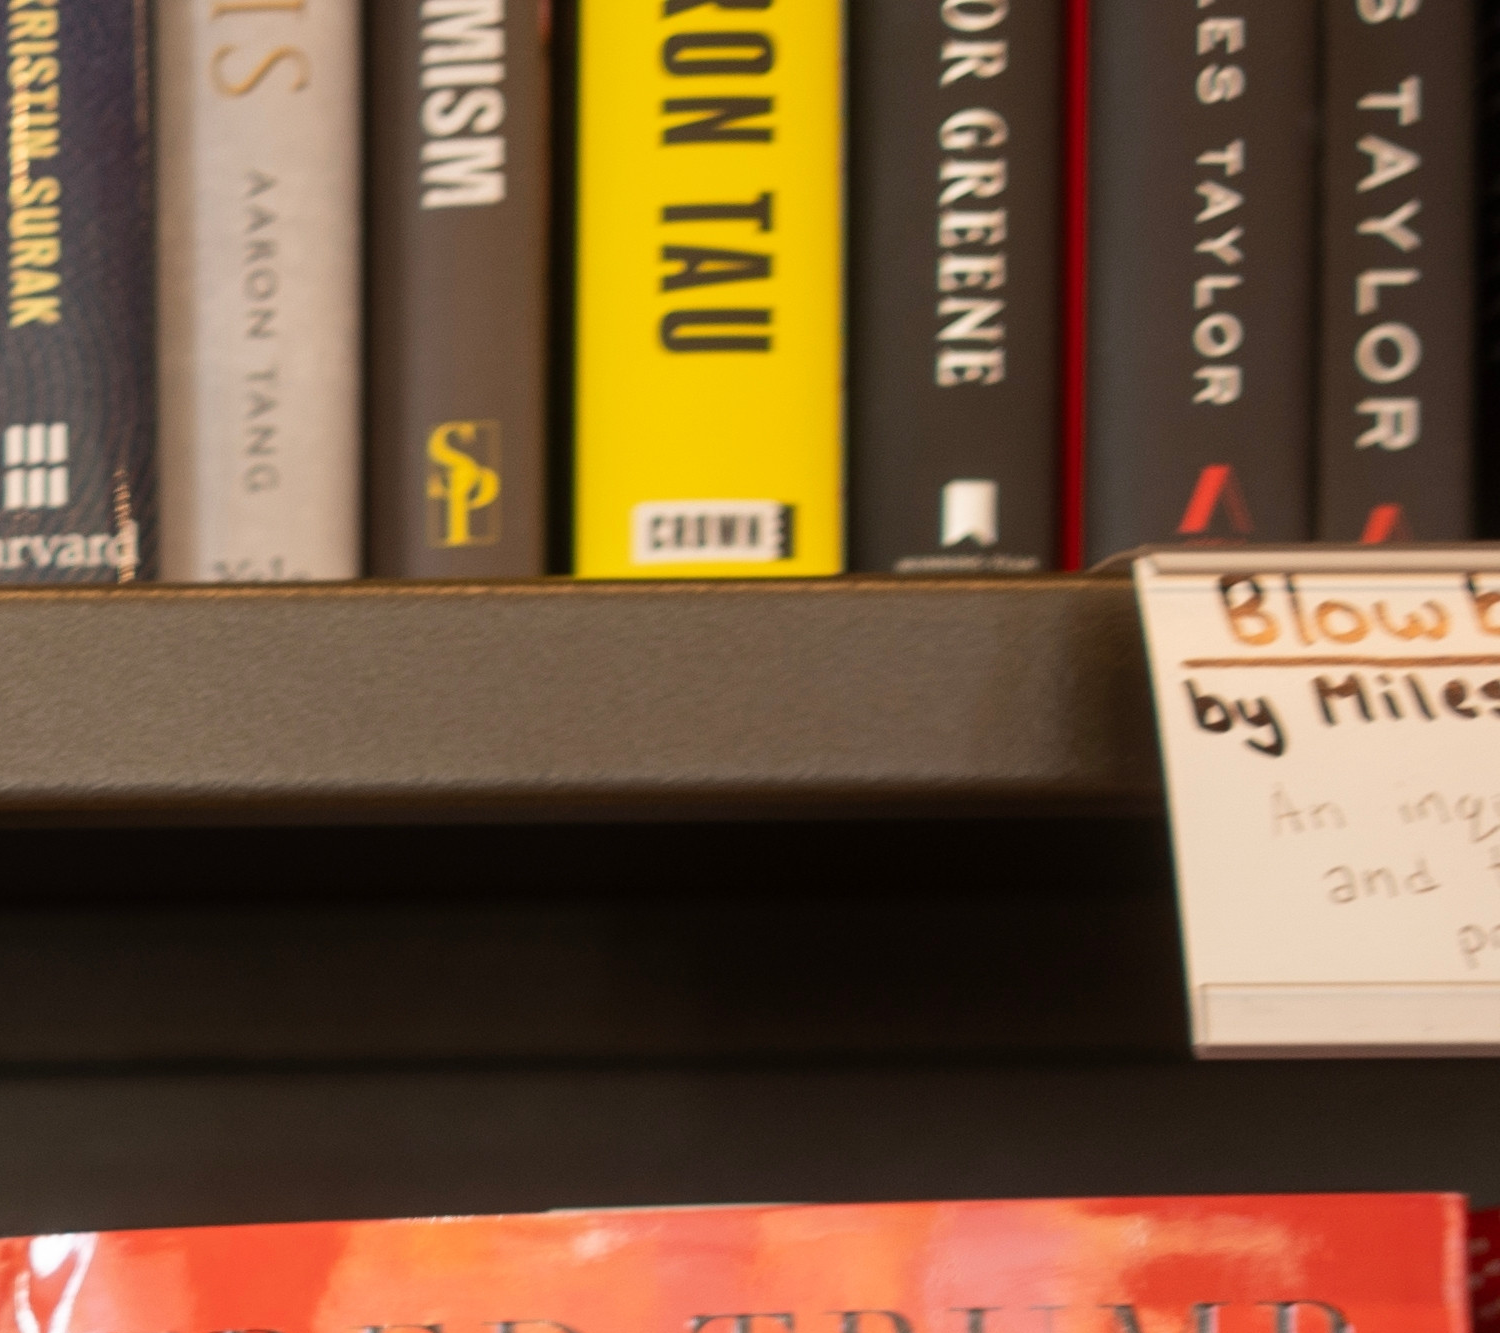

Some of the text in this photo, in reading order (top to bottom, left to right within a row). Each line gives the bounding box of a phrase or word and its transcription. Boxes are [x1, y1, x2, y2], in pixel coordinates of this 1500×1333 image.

[8, 176, 61, 329] SURAK
[658, 190, 777, 354] TAU
[936, 106, 1009, 388] GREENE
[1192, 138, 1246, 406] TAYLOR
[1354, 74, 1422, 451] TAYLOR
[243, 169, 279, 495] AARON TANG
[1181, 678, 1287, 758] by
[1270, 784, 1348, 838] An
[1323, 855, 1441, 905] and
